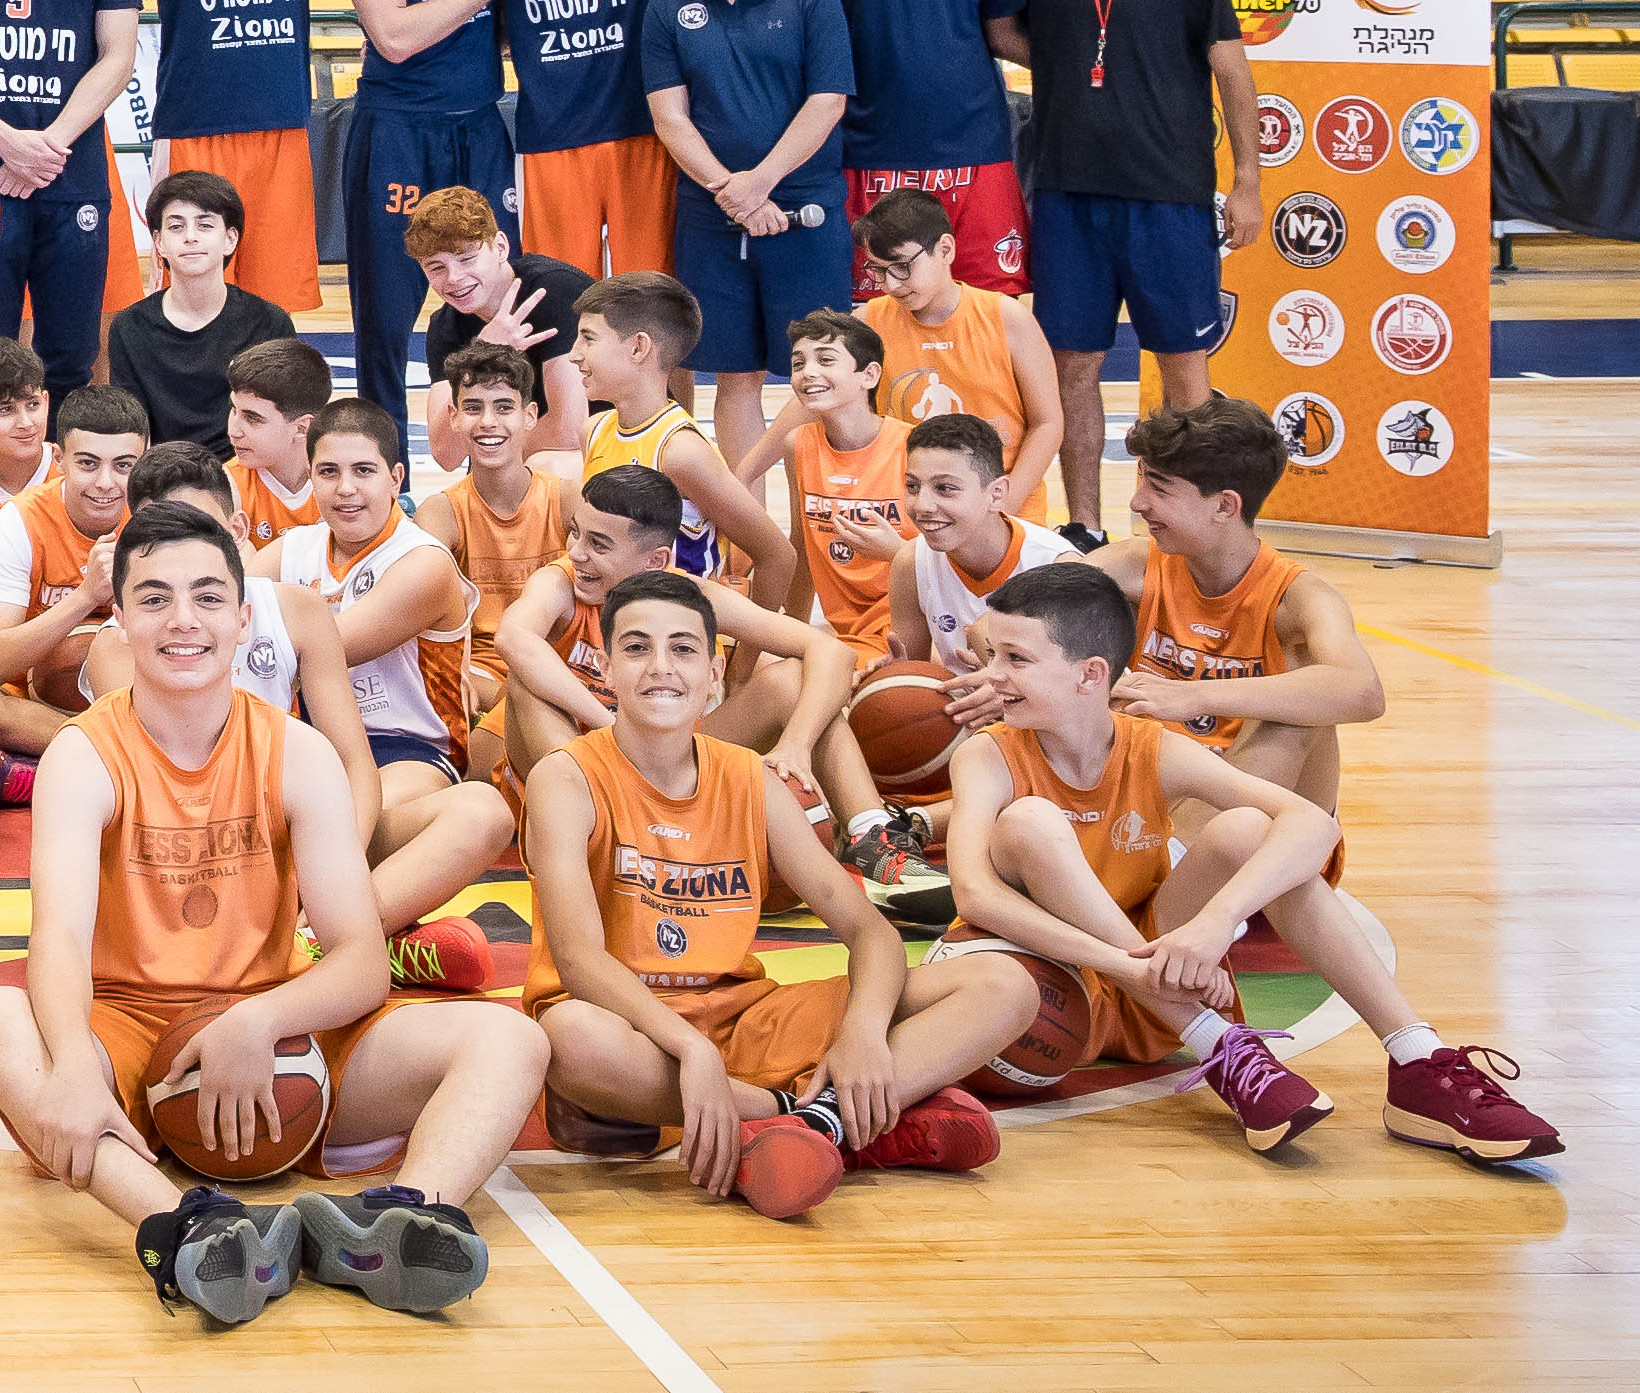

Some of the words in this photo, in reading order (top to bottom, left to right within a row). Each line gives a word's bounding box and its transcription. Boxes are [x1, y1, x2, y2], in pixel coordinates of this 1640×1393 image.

[210, 15, 294, 42] Ziona
[538, 22, 624, 55] Ziona
[1353, 25, 1434, 41] מנהלת
[51, 29, 76, 62] חי
[1359, 40, 1429, 55] הליגה
[385, 183, 421, 215] 32
[1289, 212, 1327, 247] NZ
[834, 544, 850, 558] NZ
[662, 864, 751, 899] ZIONA
[640, 893, 710, 917] BASKETBALL
[662, 926, 679, 949] NZ
